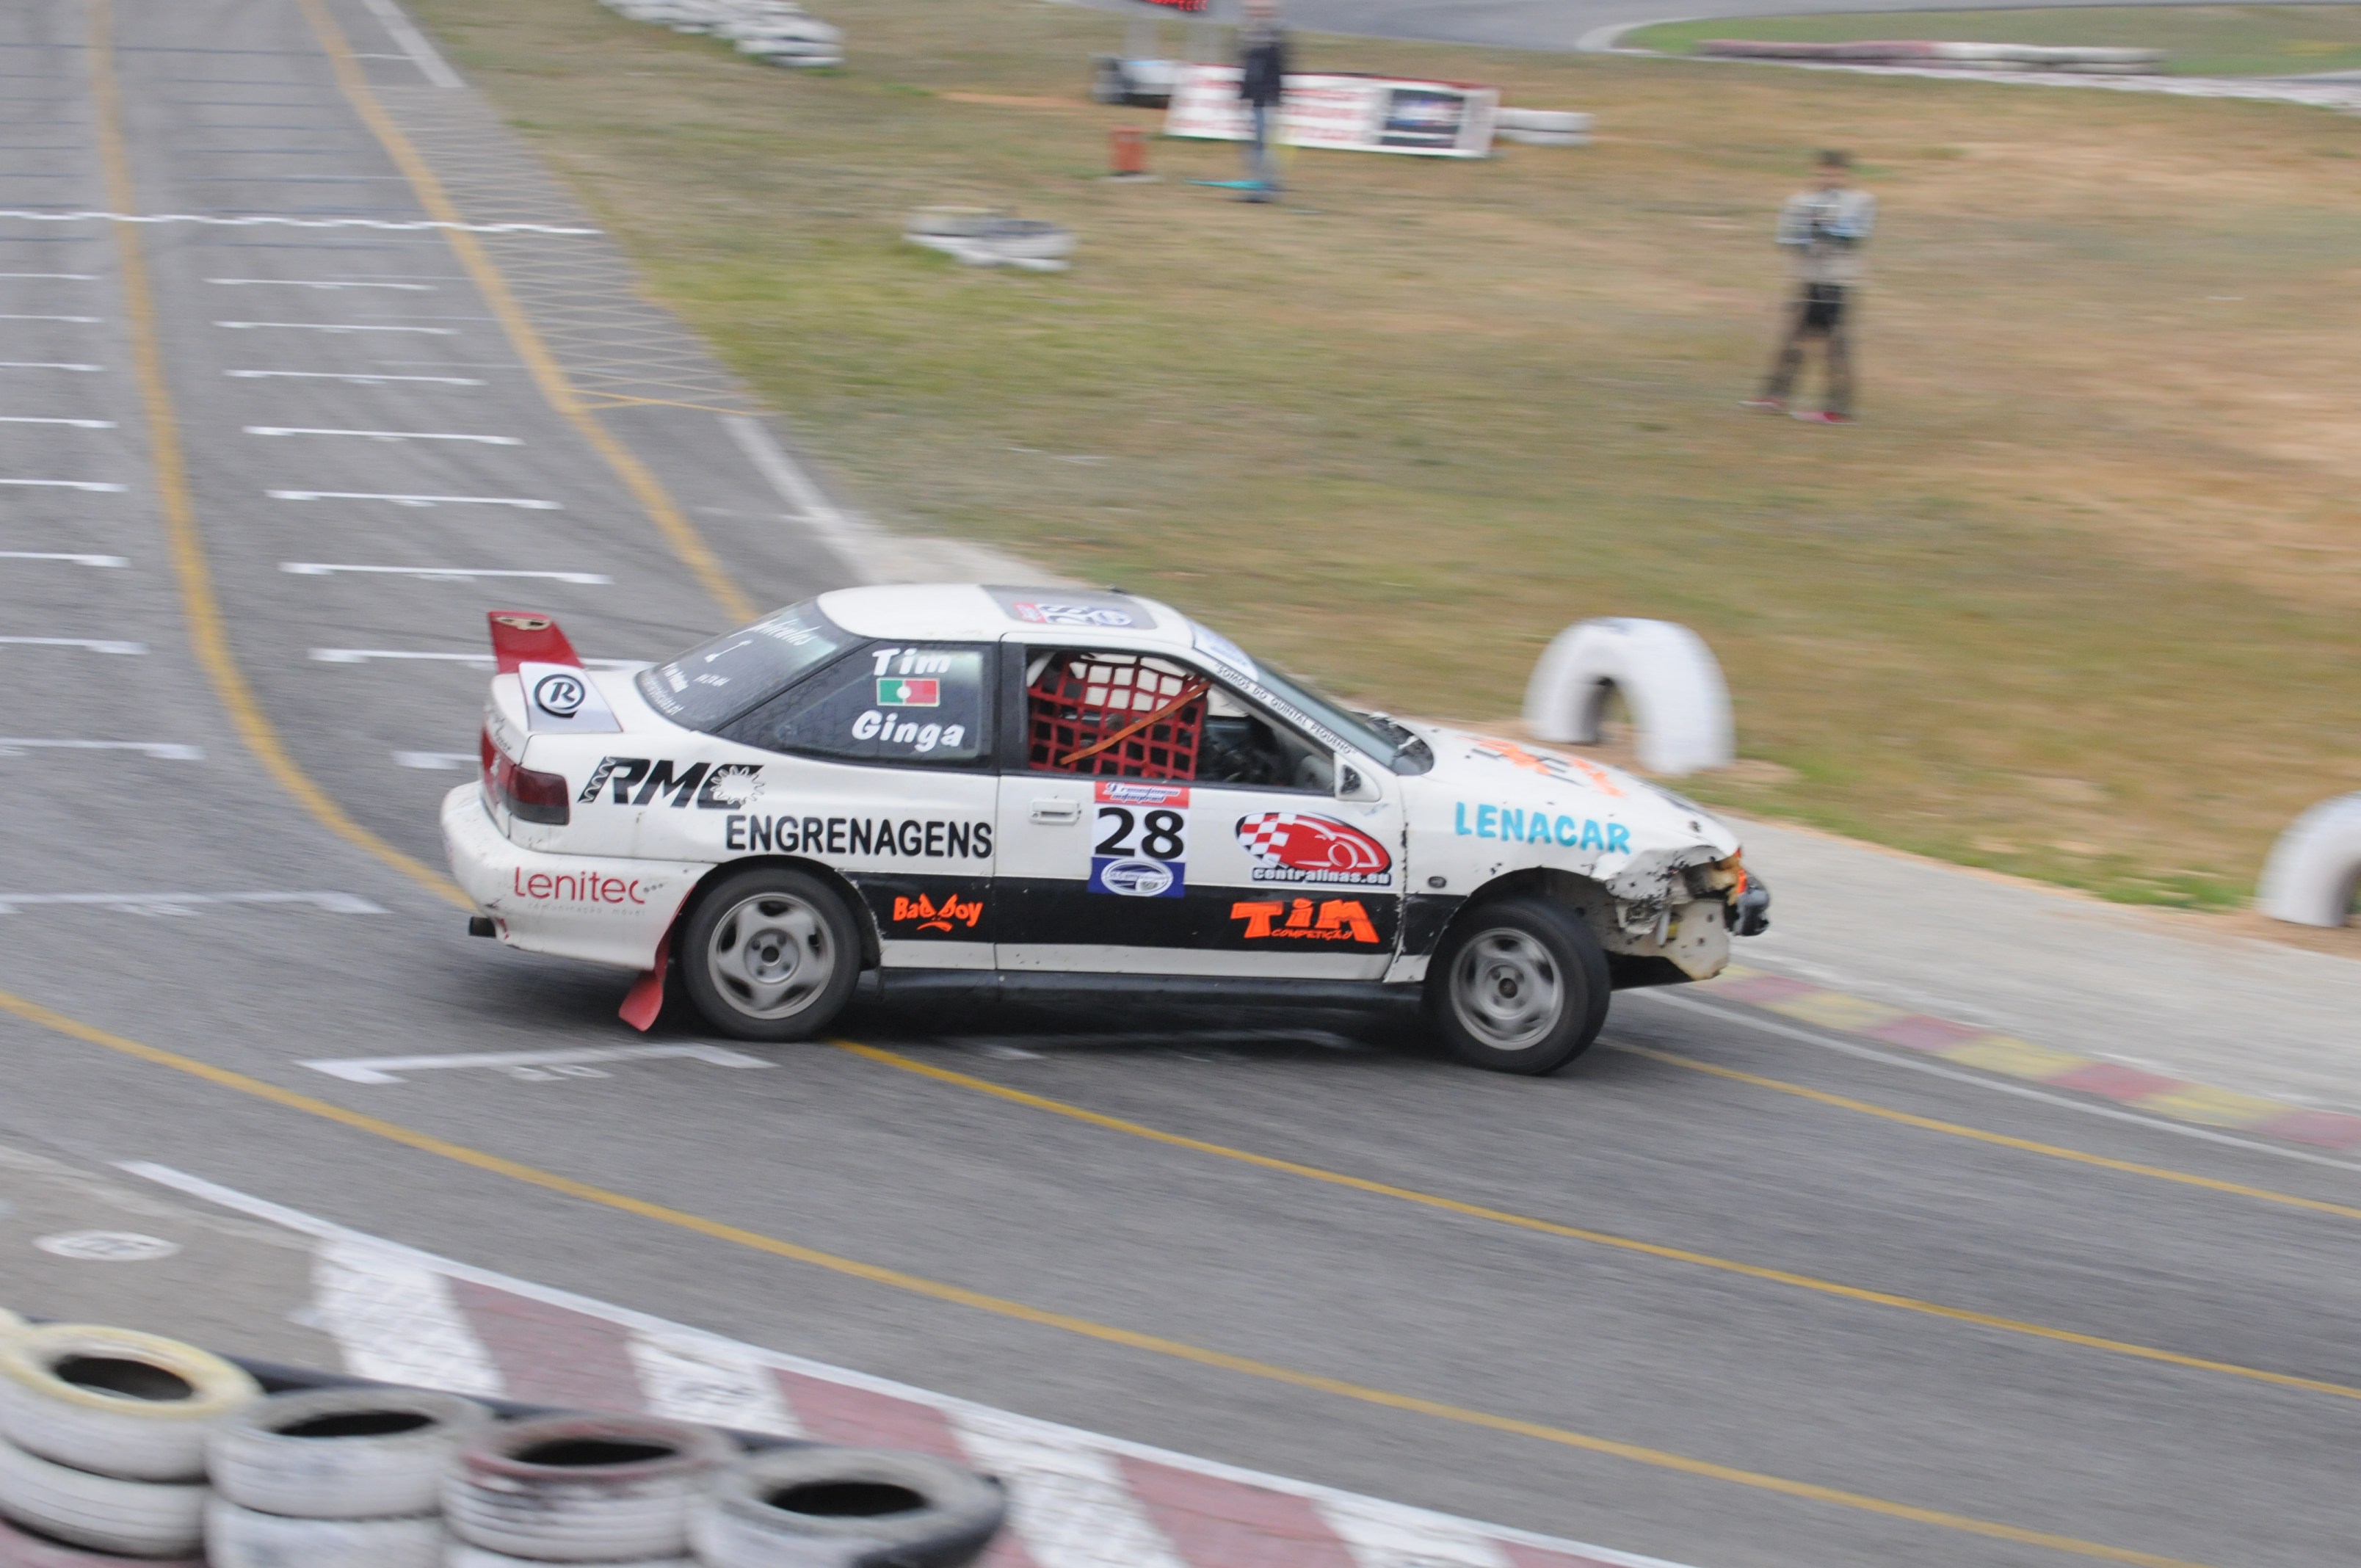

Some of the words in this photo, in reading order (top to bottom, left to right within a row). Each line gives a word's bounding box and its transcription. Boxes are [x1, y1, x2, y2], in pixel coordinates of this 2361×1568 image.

[871, 647, 952, 676] Tim
[852, 709, 965, 753] Ginga
[726, 814, 993, 858] ENGRENAGENS
[1095, 806, 1185, 861] 28
[1454, 801, 1631, 856] LENACAR
[1252, 867, 1390, 885] centralinas.eu
